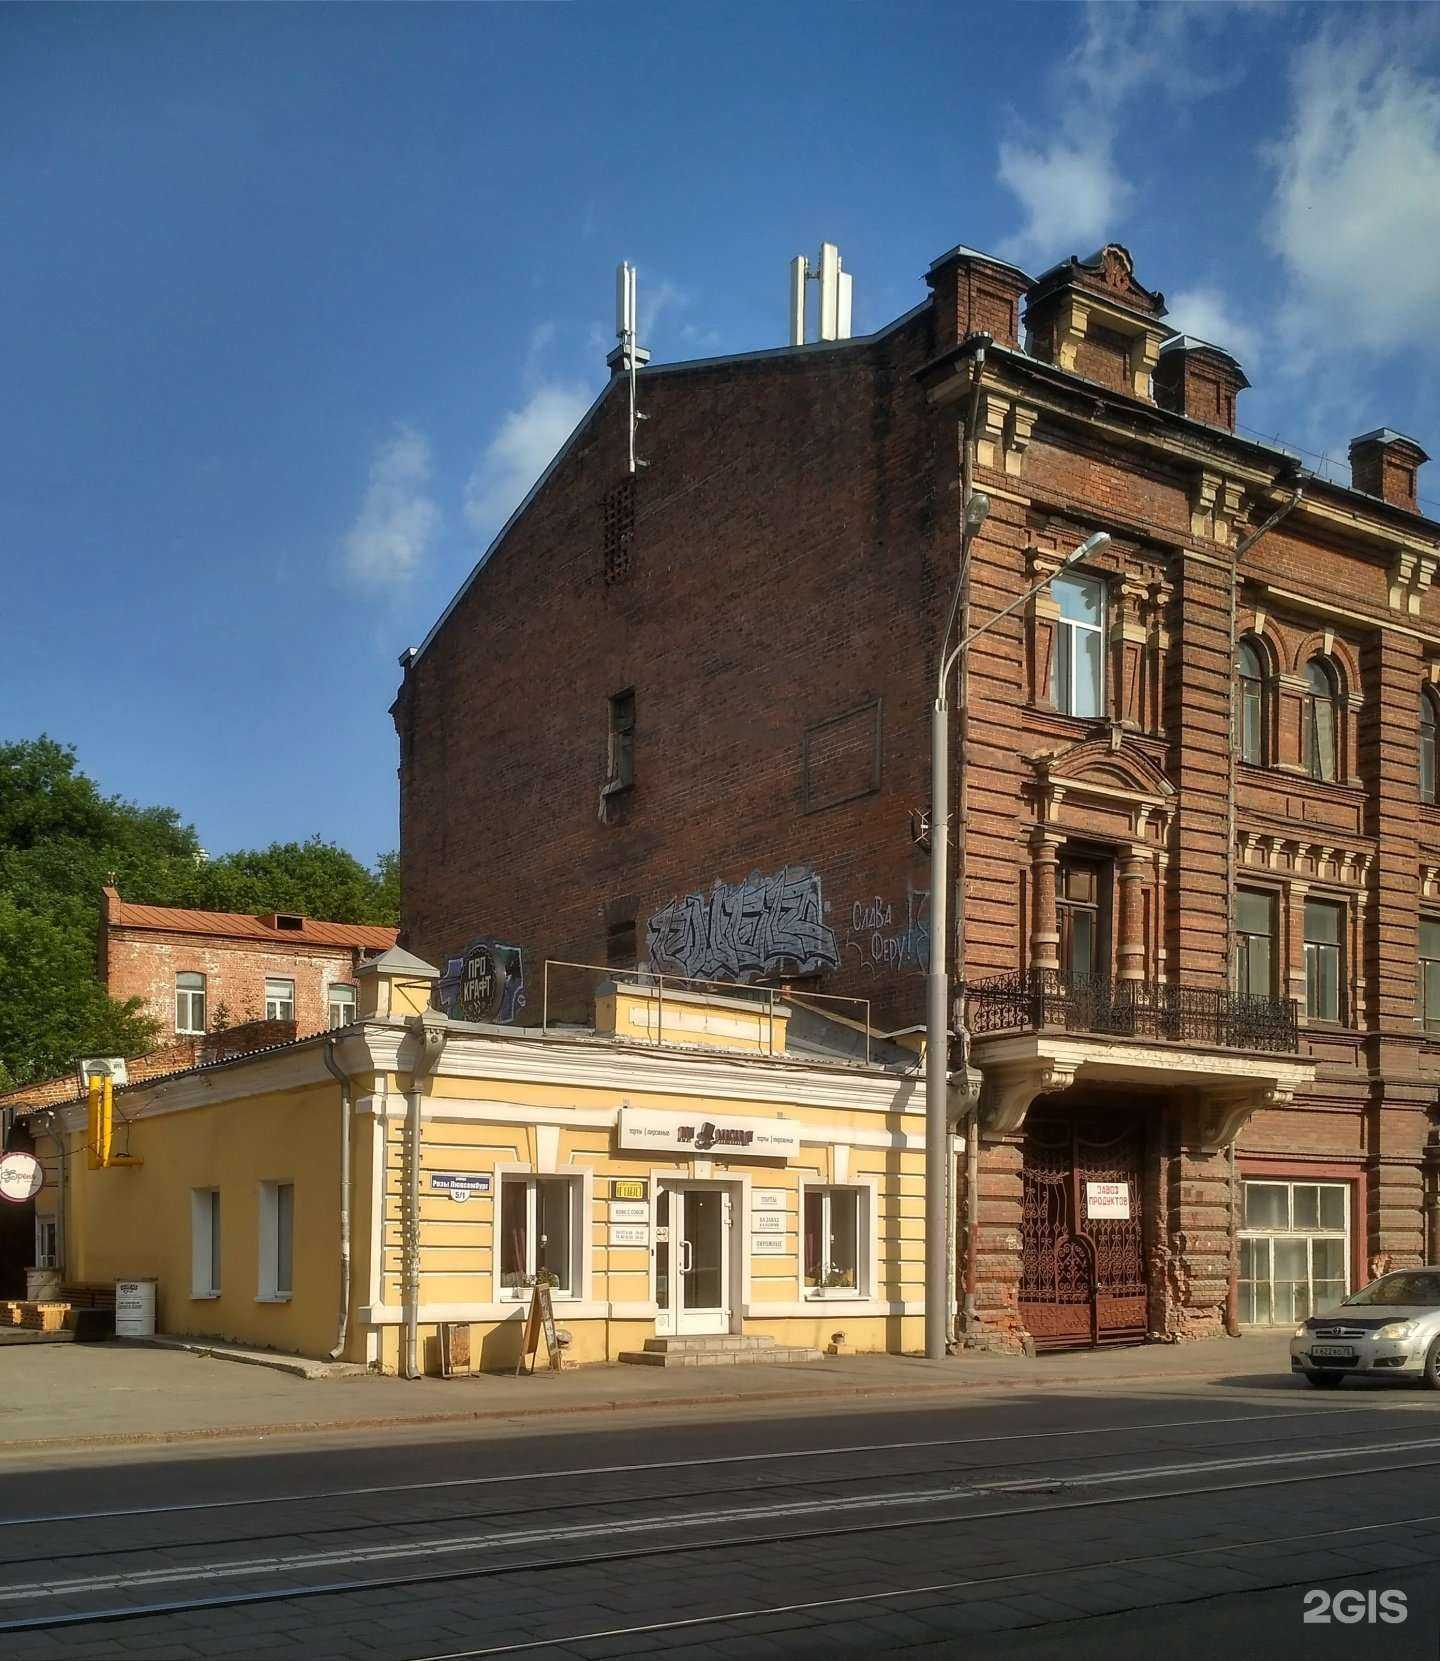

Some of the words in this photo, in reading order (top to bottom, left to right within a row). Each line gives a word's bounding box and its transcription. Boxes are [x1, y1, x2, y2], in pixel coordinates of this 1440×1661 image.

[468, 956, 487, 980] ПРО
[463, 975, 492, 1002] КРАФТ
[432, 1179, 449, 1188] Розы
[450, 1180, 489, 1190] Люксембург
[1096, 1185, 1119, 1195] ЗАВОЗ
[1088, 1196, 1128, 1206] ПРОДУКТОВ
